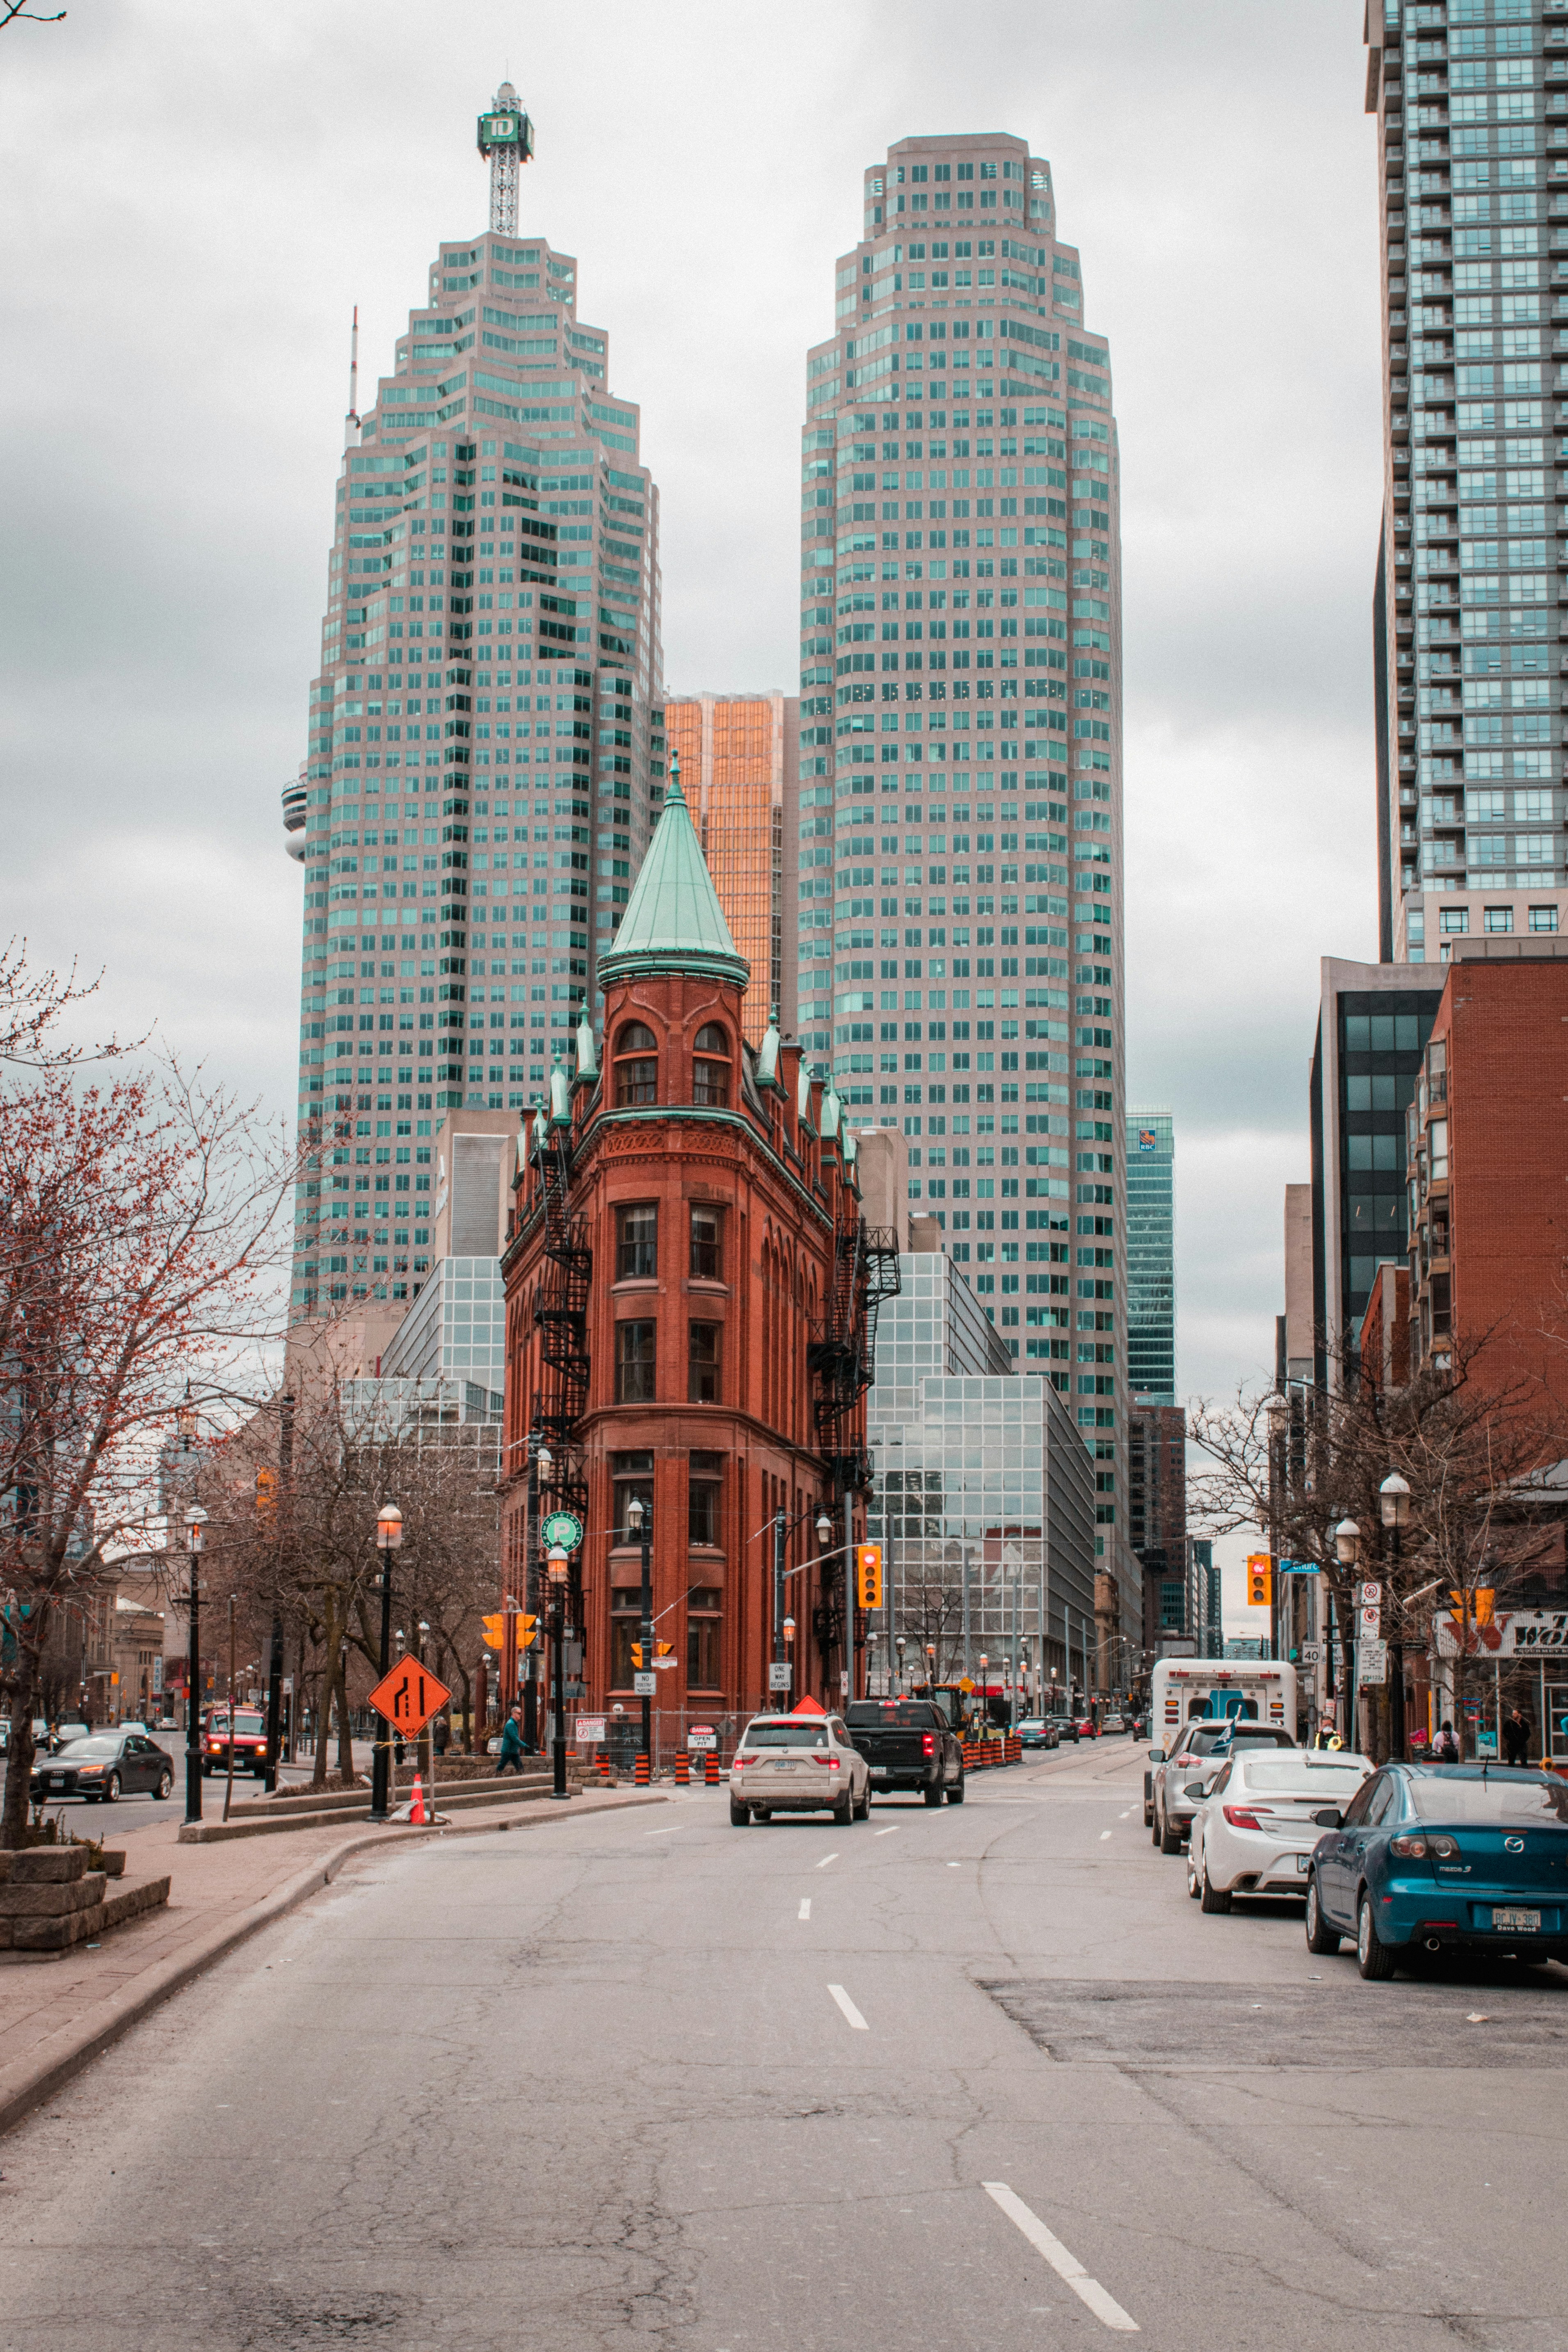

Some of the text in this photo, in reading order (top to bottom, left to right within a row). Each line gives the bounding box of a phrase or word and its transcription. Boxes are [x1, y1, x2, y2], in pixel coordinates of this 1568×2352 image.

[487, 117, 513, 136] TD
[543, 1513, 580, 1531] MUNICIPAL
[555, 1522, 570, 1538] P
[1293, 1561, 1320, 1570] Churc
[1305, 1651, 1318, 1660] 40
